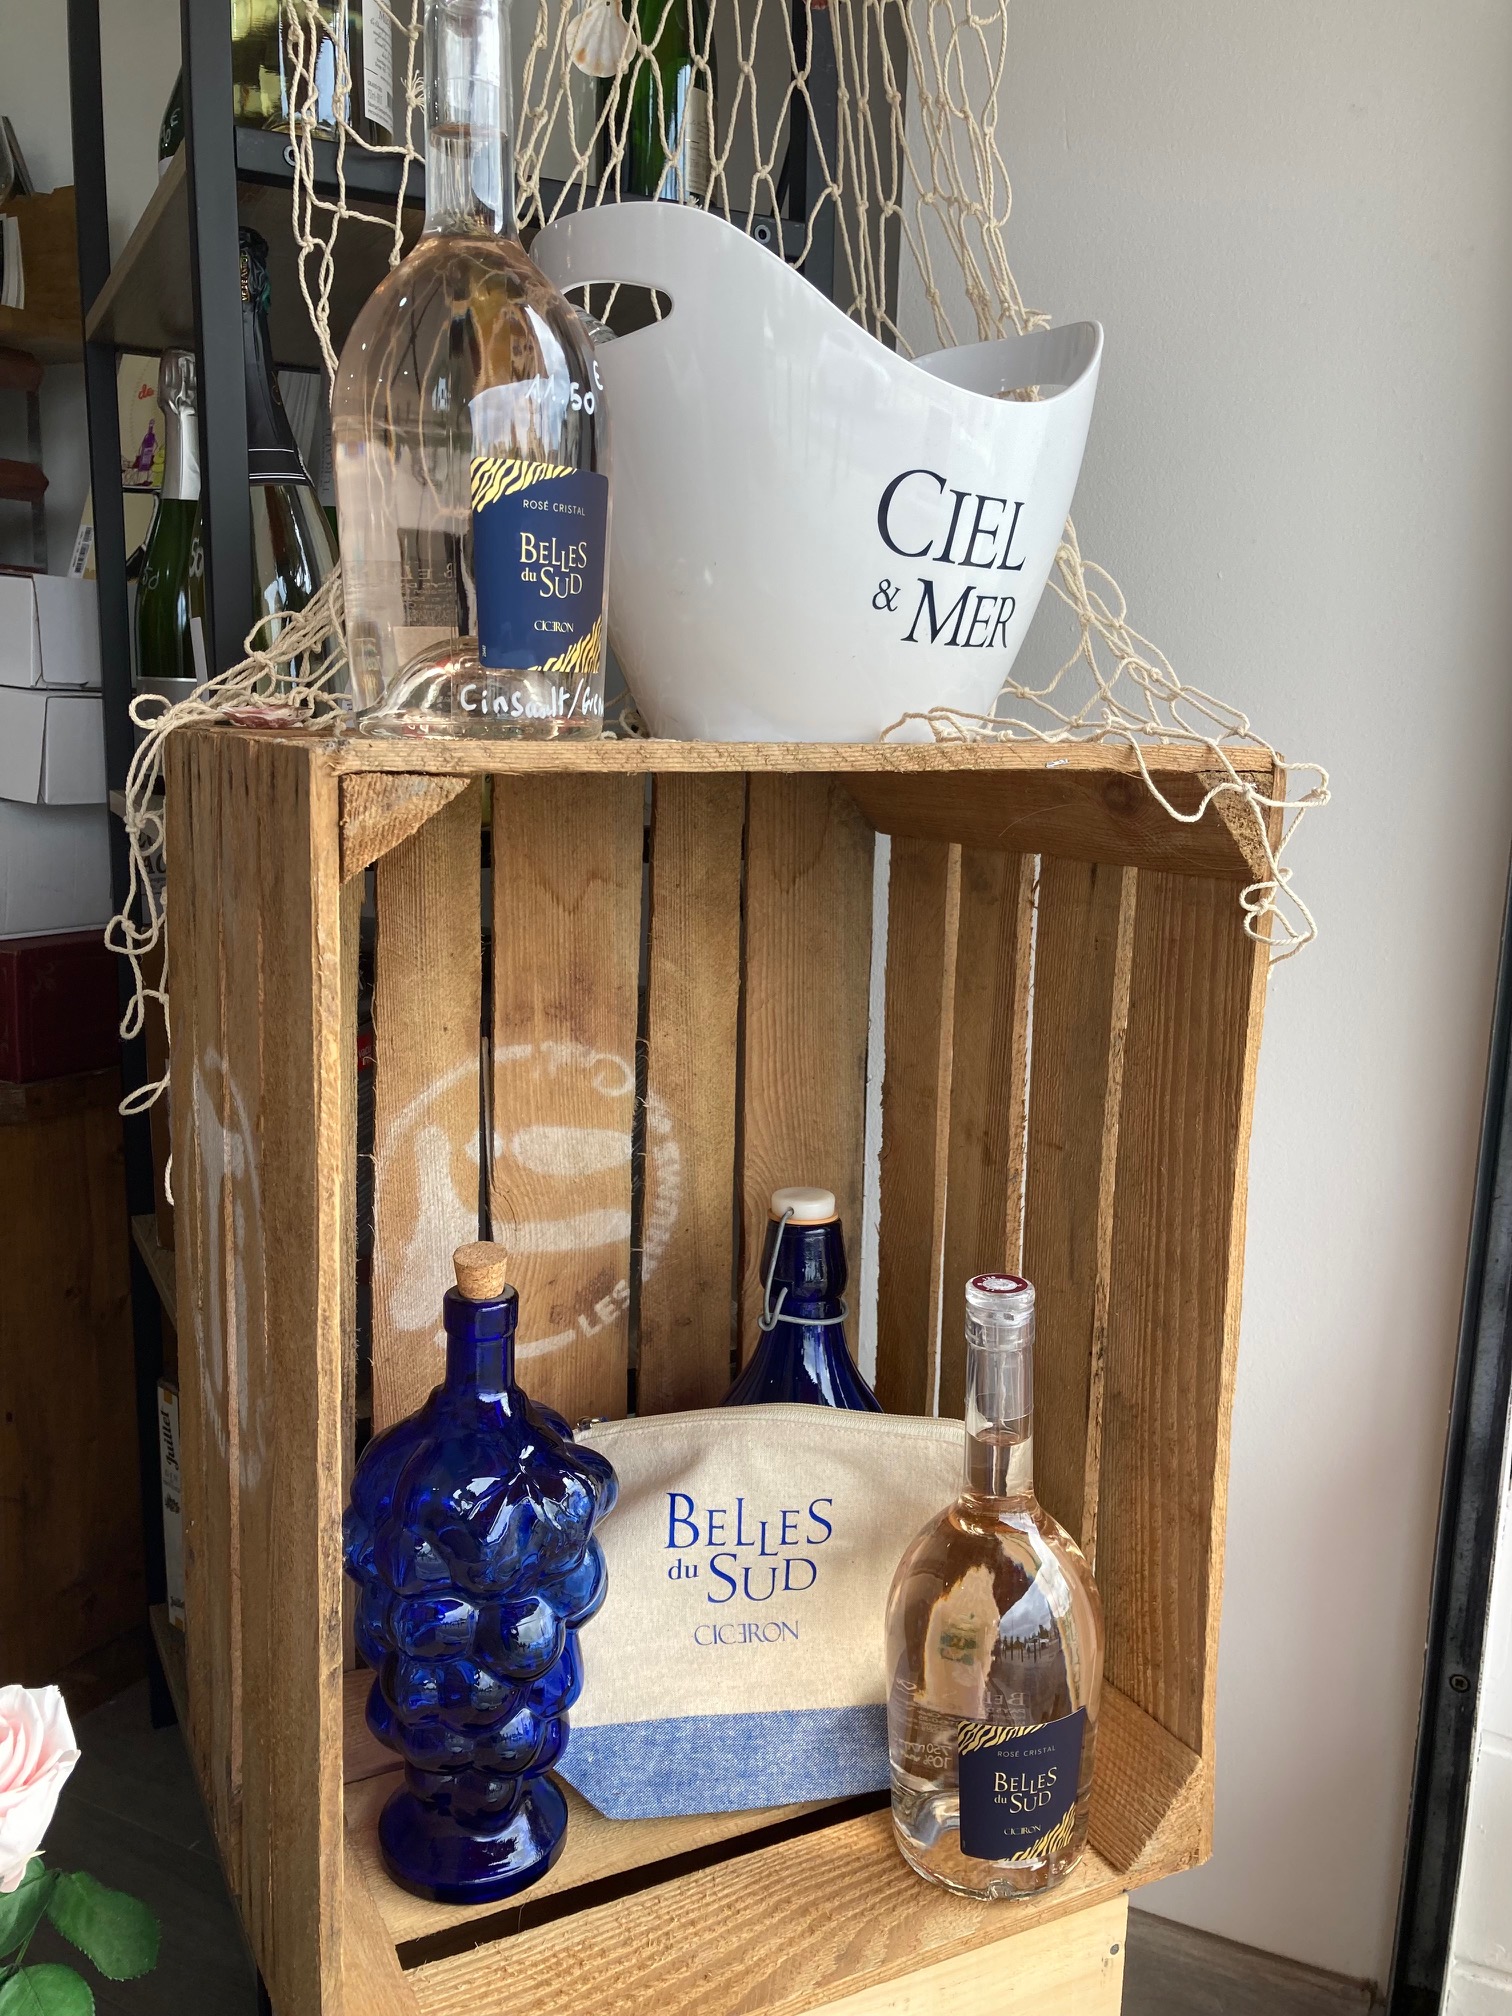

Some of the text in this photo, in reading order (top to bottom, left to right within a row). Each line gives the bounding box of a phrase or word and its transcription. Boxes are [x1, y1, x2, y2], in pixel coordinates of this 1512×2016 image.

[523, 499, 586, 516] ROSÉ CRISTAL
[877, 469, 1027, 571] CIEL
[519, 532, 587, 572] BELLES
[521, 566, 583, 599] du SUD
[872, 577, 1016, 648] & MER
[160, 1411, 180, 1471] Juillet
[664, 1492, 833, 1557] BELLES
[668, 1552, 817, 1604] du SUD
[997, 1745, 1056, 1758] ROSÉ CRISTAL
[993, 1766, 1058, 1795] BELLES
[994, 1789, 1052, 1814] du SUD
